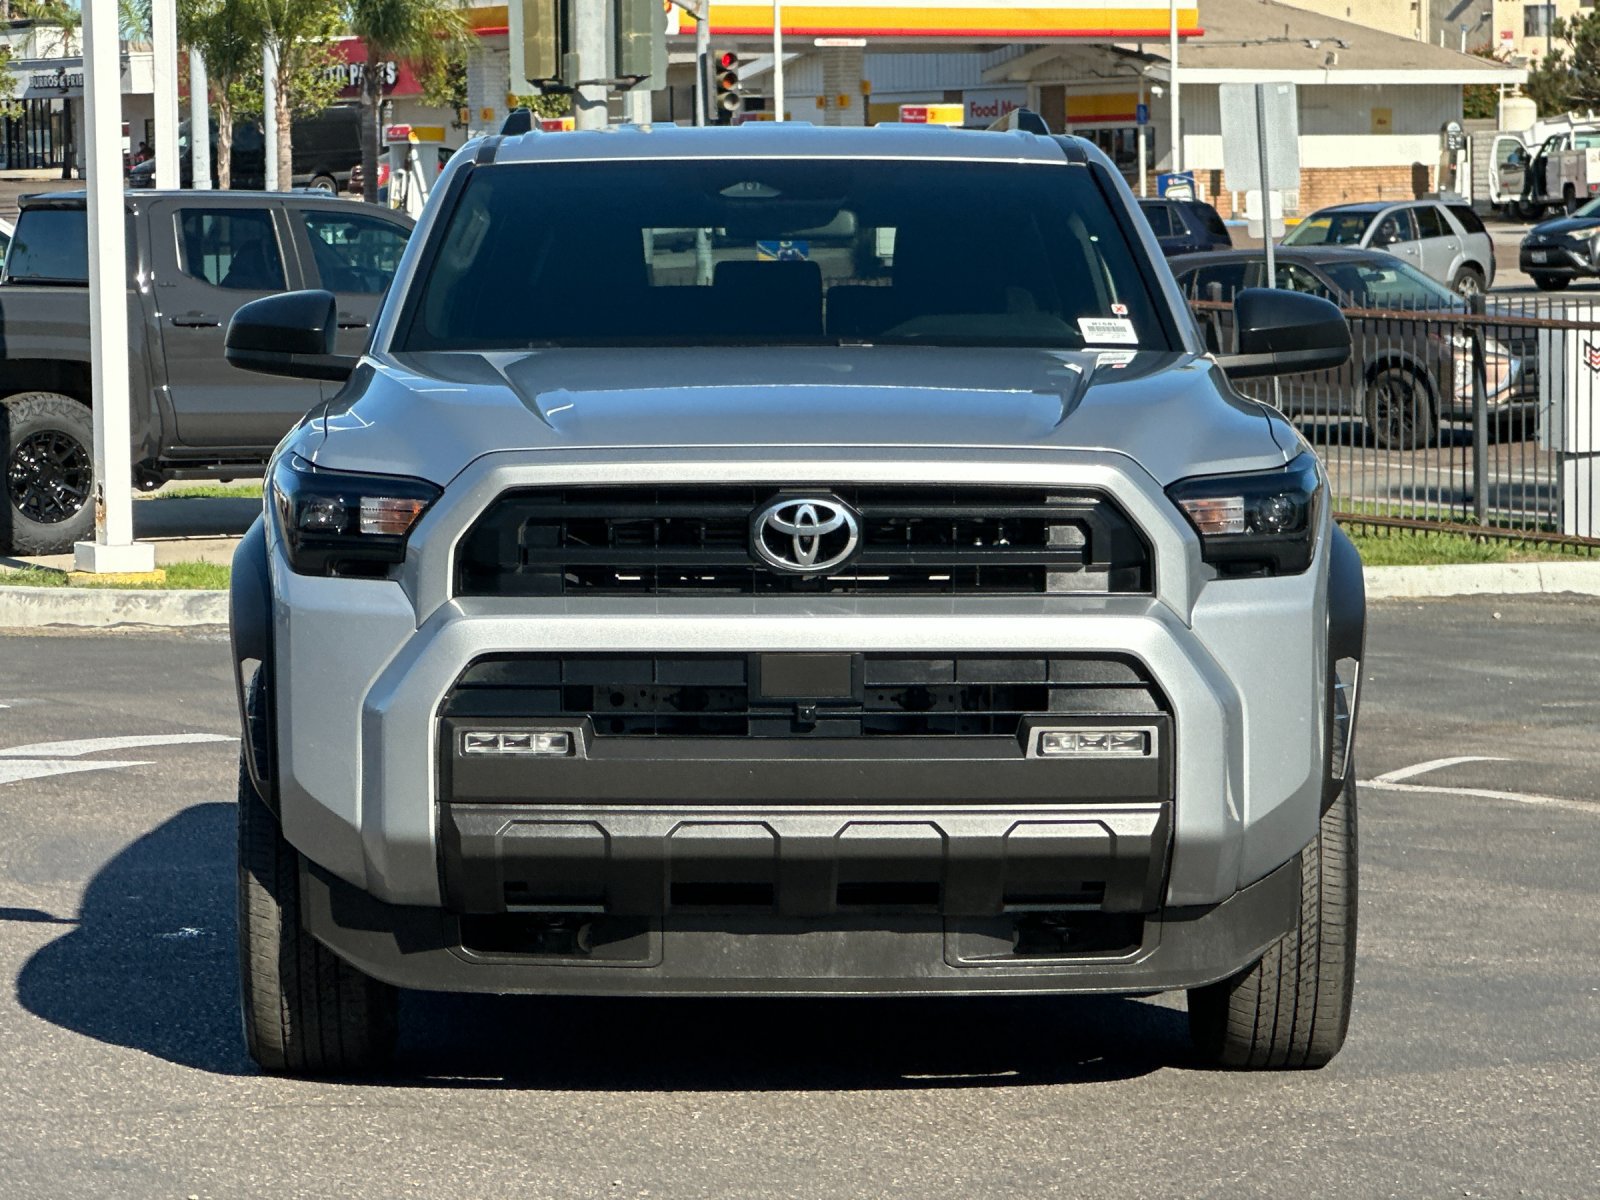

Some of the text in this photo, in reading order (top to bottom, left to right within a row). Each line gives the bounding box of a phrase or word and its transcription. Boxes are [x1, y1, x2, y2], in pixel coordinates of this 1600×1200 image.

[29, 75, 58, 88] BURROS
[349, 61, 396, 85] PTS
[970, 98, 998, 118] Food
